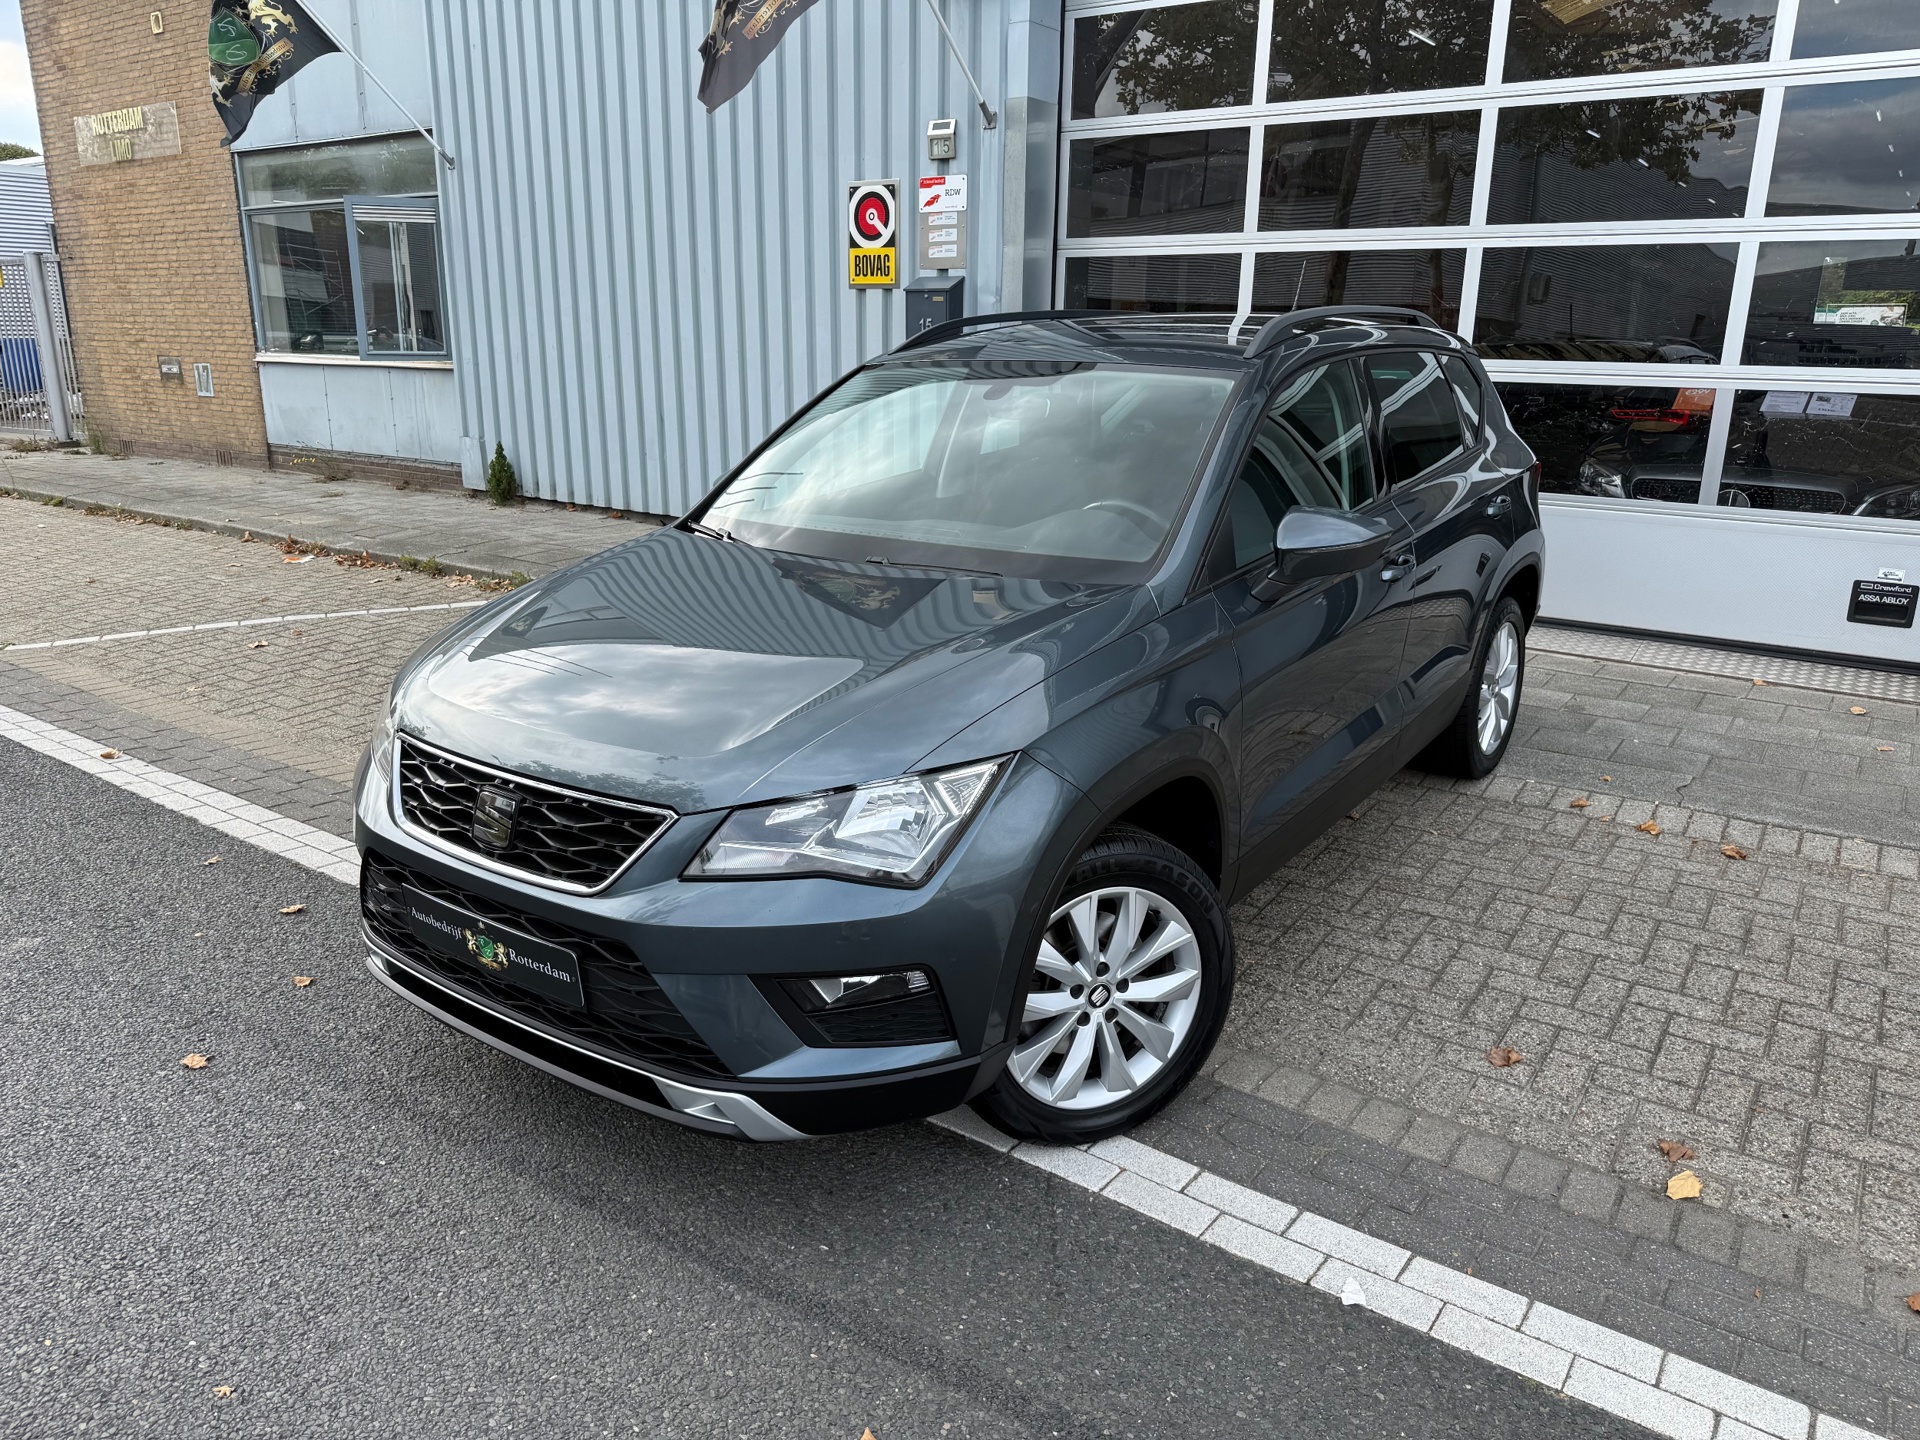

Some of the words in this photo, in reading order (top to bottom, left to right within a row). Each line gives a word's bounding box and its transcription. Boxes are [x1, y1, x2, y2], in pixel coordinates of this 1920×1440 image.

[91, 106, 144, 136] ROTTERDAM
[110, 138, 132, 161] LIMO
[934, 139, 950, 155] 15
[945, 188, 961, 197] RDW
[854, 253, 890, 277] BOVAG
[919, 318, 932, 331] 15
[1874, 583, 1912, 593] Crawford
[1858, 594, 1880, 603] ASSA
[1881, 596, 1909, 605] ABLOY
[1076, 858, 1120, 882] ALL
[411, 906, 462, 940] Autobedrijf
[509, 948, 571, 983] Rotterdam
